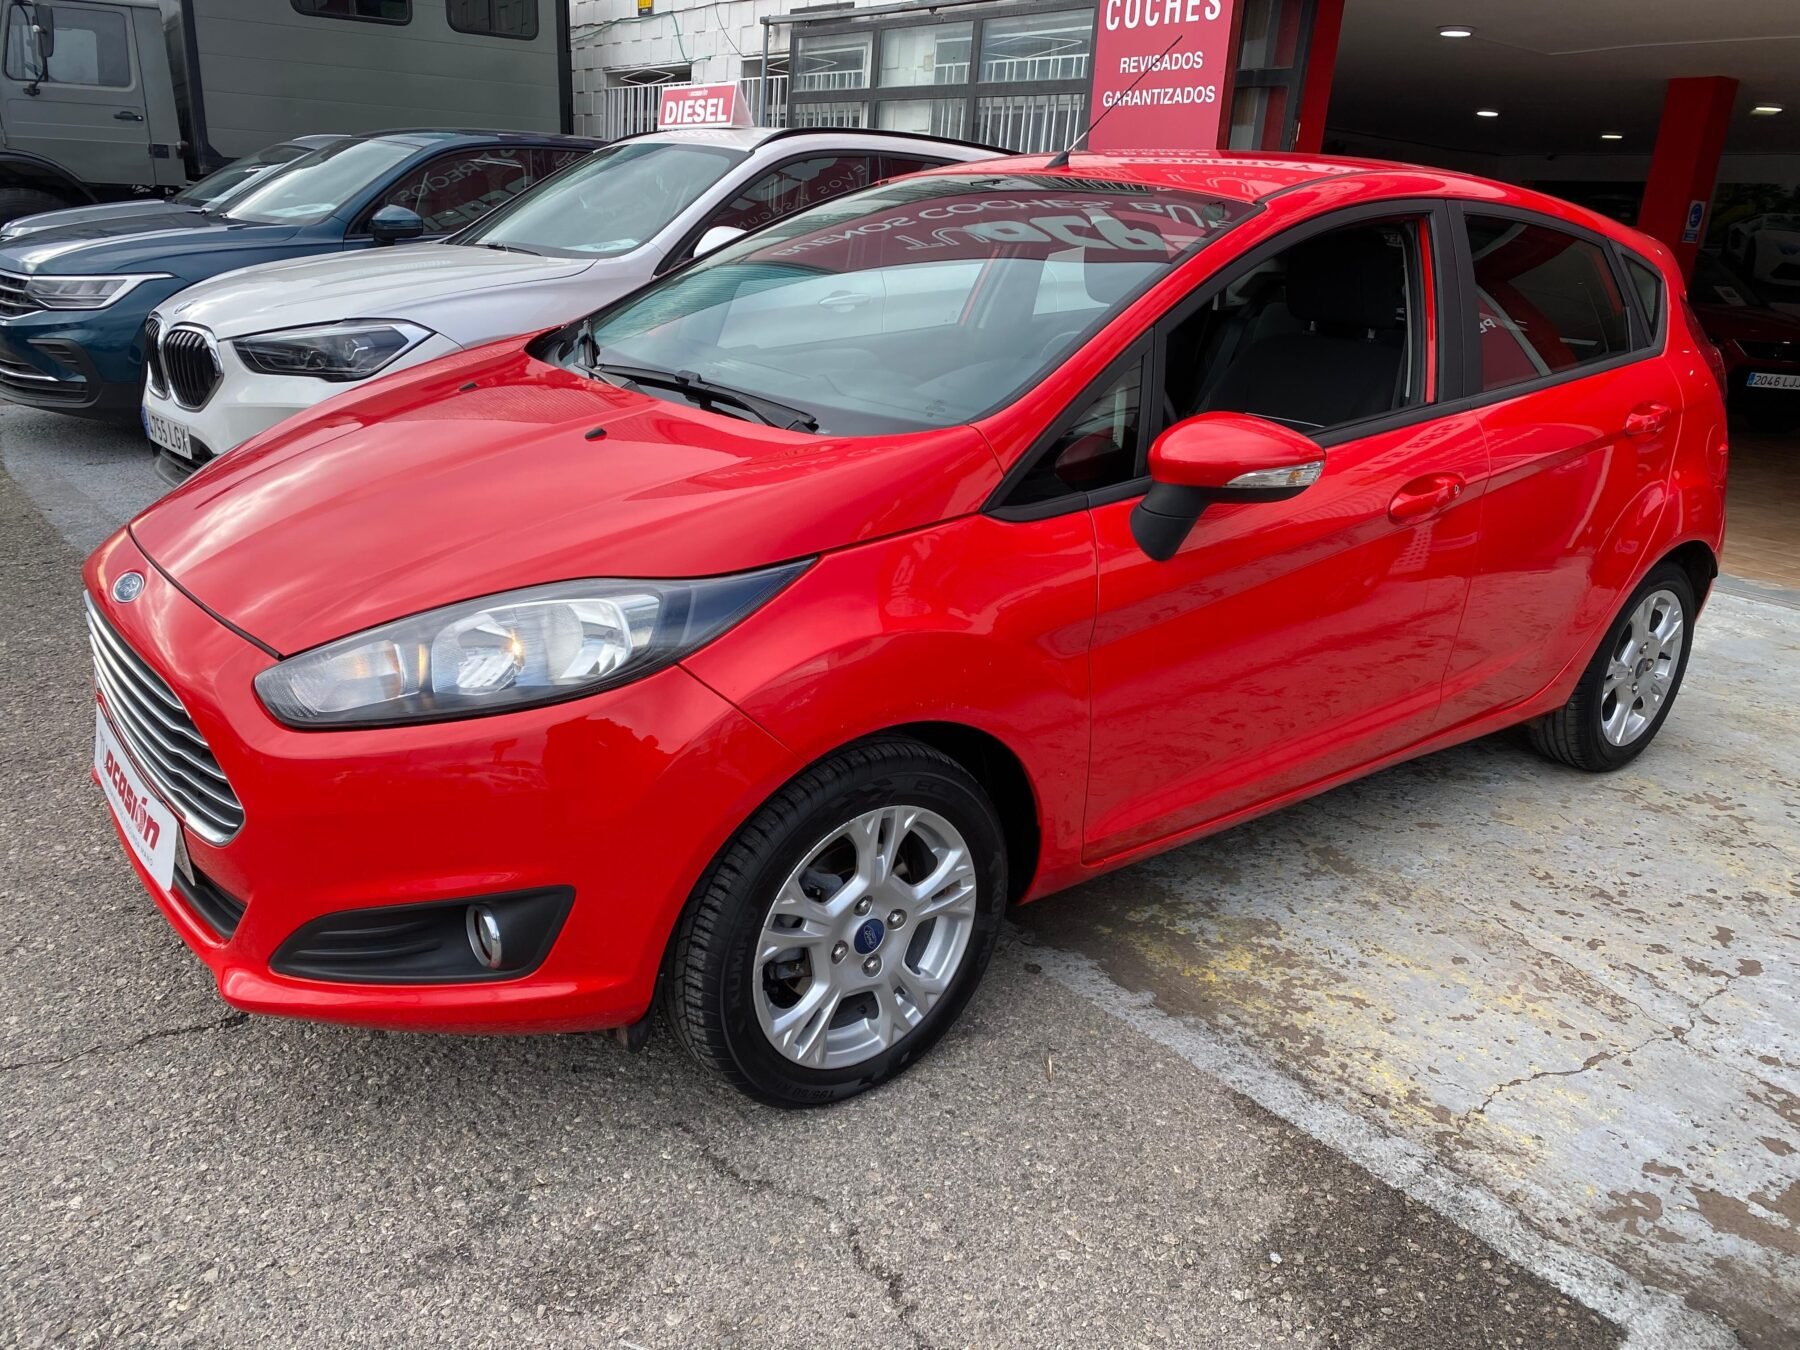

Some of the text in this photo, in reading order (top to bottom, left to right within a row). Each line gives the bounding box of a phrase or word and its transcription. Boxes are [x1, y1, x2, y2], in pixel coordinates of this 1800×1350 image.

[1105, 0, 1222, 31] COCHES
[1120, 51, 1204, 74] REVISADOS
[1103, 85, 1216, 107] GARANTIZADOS
[664, 98, 727, 124] DIESEL
[1754, 375, 1781, 387] 2046
